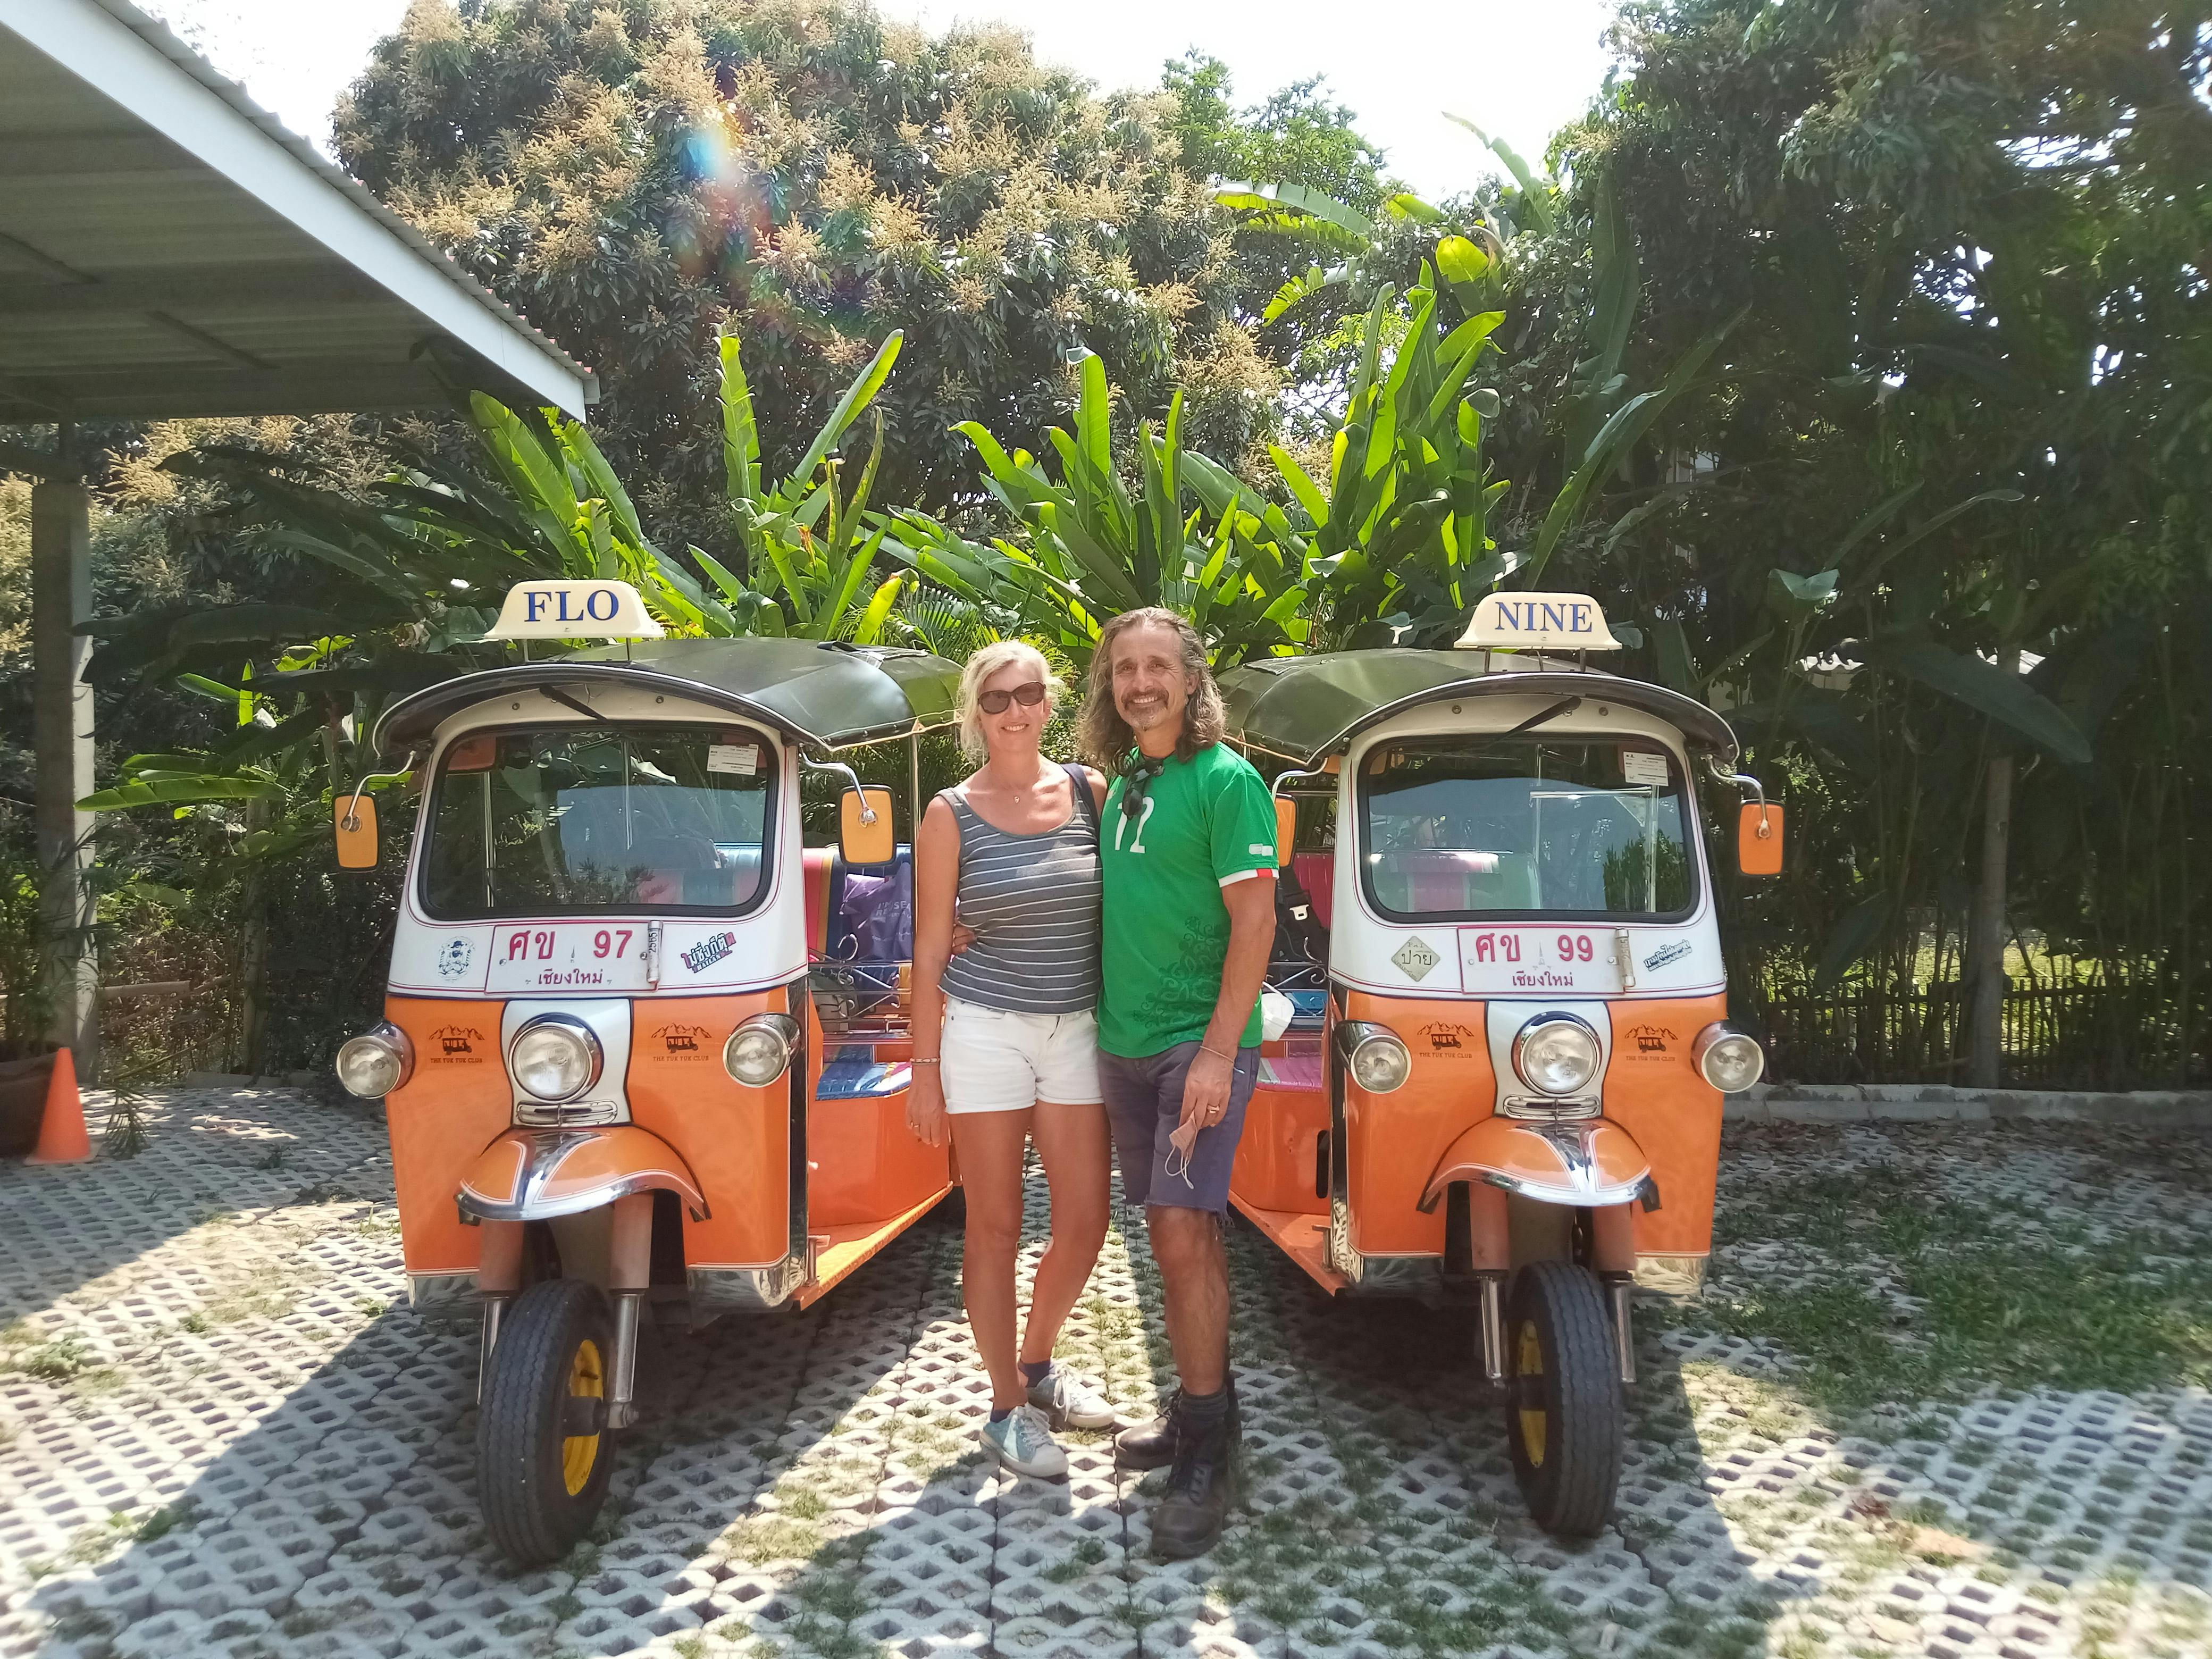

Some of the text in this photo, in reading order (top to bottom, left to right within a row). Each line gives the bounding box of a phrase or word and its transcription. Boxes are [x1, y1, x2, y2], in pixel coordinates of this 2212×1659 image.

[524, 590, 619, 622] FLO
[1495, 601, 1593, 632] NINE
[509, 930, 556, 961] ศข
[593, 930, 633, 958] 97
[648, 932, 658, 953] 2565
[1476, 933, 1593, 962] ศข 99
[1402, 950, 1431, 966] ปาย
[538, 968, 604, 984] เชียงใหม่
[1512, 970, 1573, 986] เชียงใหม่
